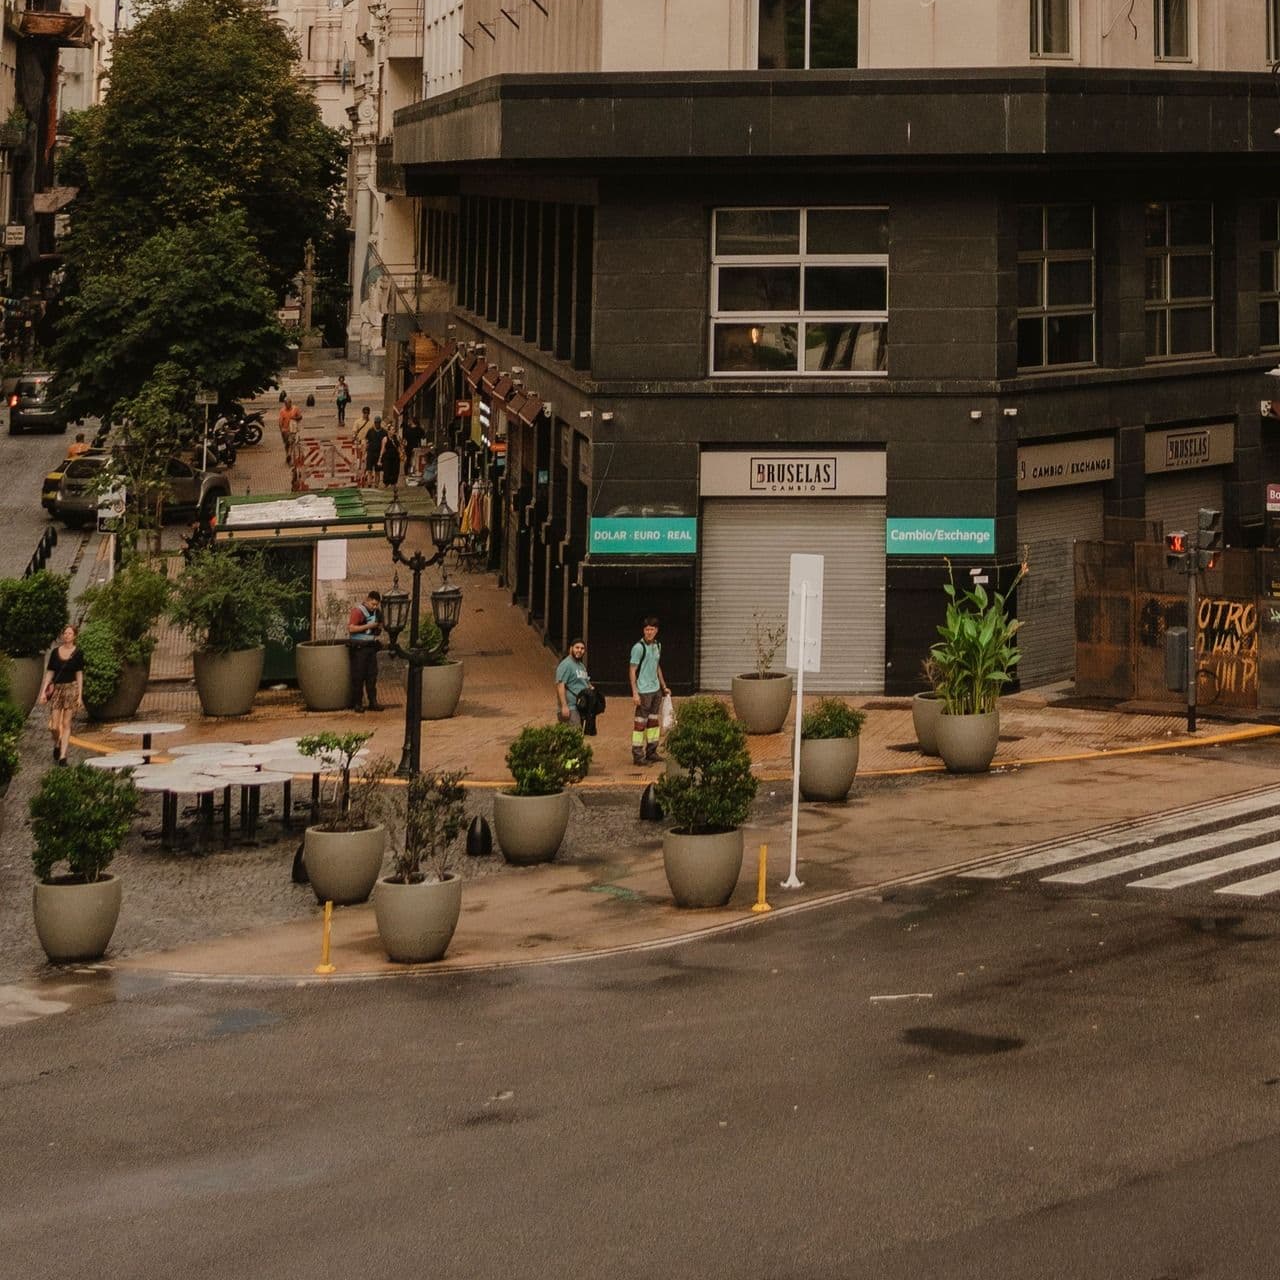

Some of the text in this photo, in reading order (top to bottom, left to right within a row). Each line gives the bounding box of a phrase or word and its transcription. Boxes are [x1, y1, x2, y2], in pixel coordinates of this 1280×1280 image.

[756, 463, 831, 483] BRUSELAS
[1032, 464, 1063, 479] CAMBIO
[1071, 458, 1111, 474] EXCHANGE
[594, 530, 692, 540] DOLAR EURO REAL
[890, 528, 991, 543] Cambio/Exchange
